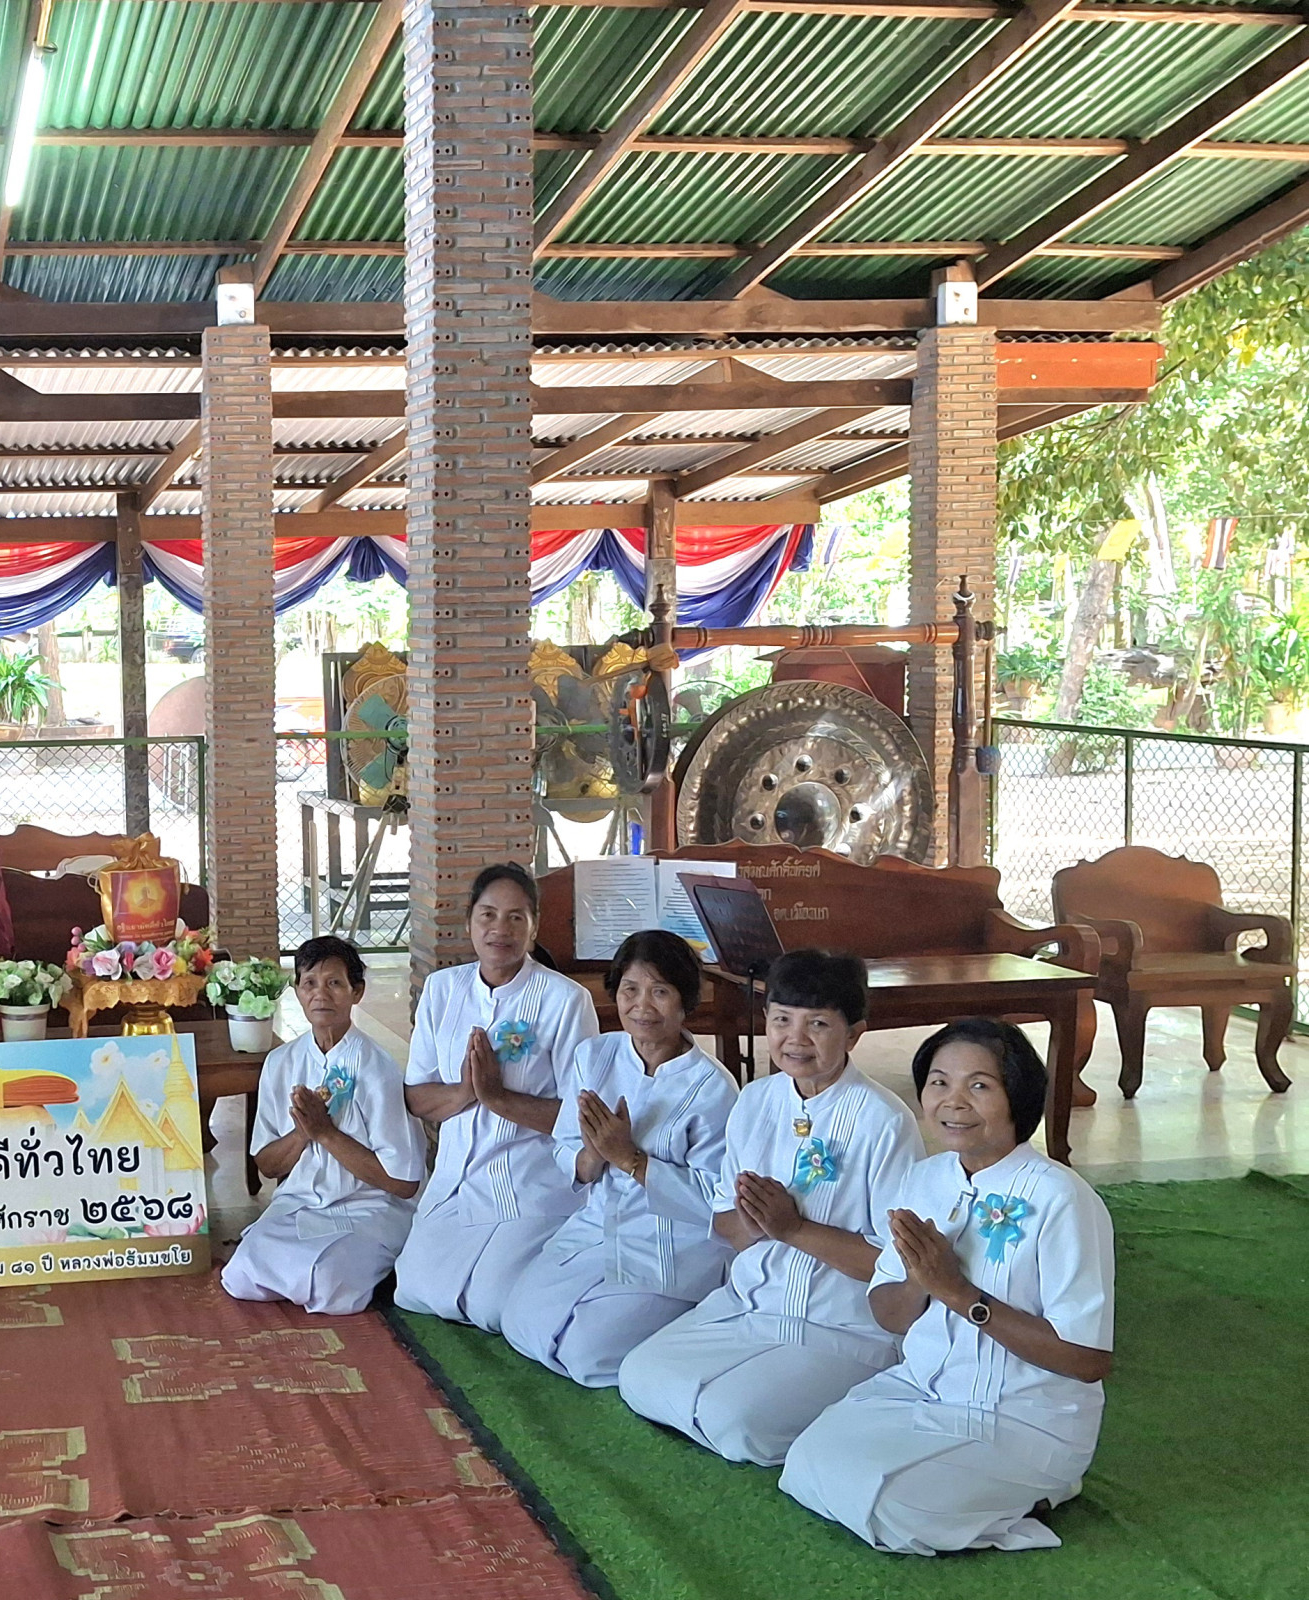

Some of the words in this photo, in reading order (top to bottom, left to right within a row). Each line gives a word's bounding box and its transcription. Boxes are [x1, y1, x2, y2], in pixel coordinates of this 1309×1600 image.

[80, 1192, 194, 1224] ๒๕๖๘
[10, 1261, 35, 1274] ๘๑
[40, 1254, 53, 1272] ปี
